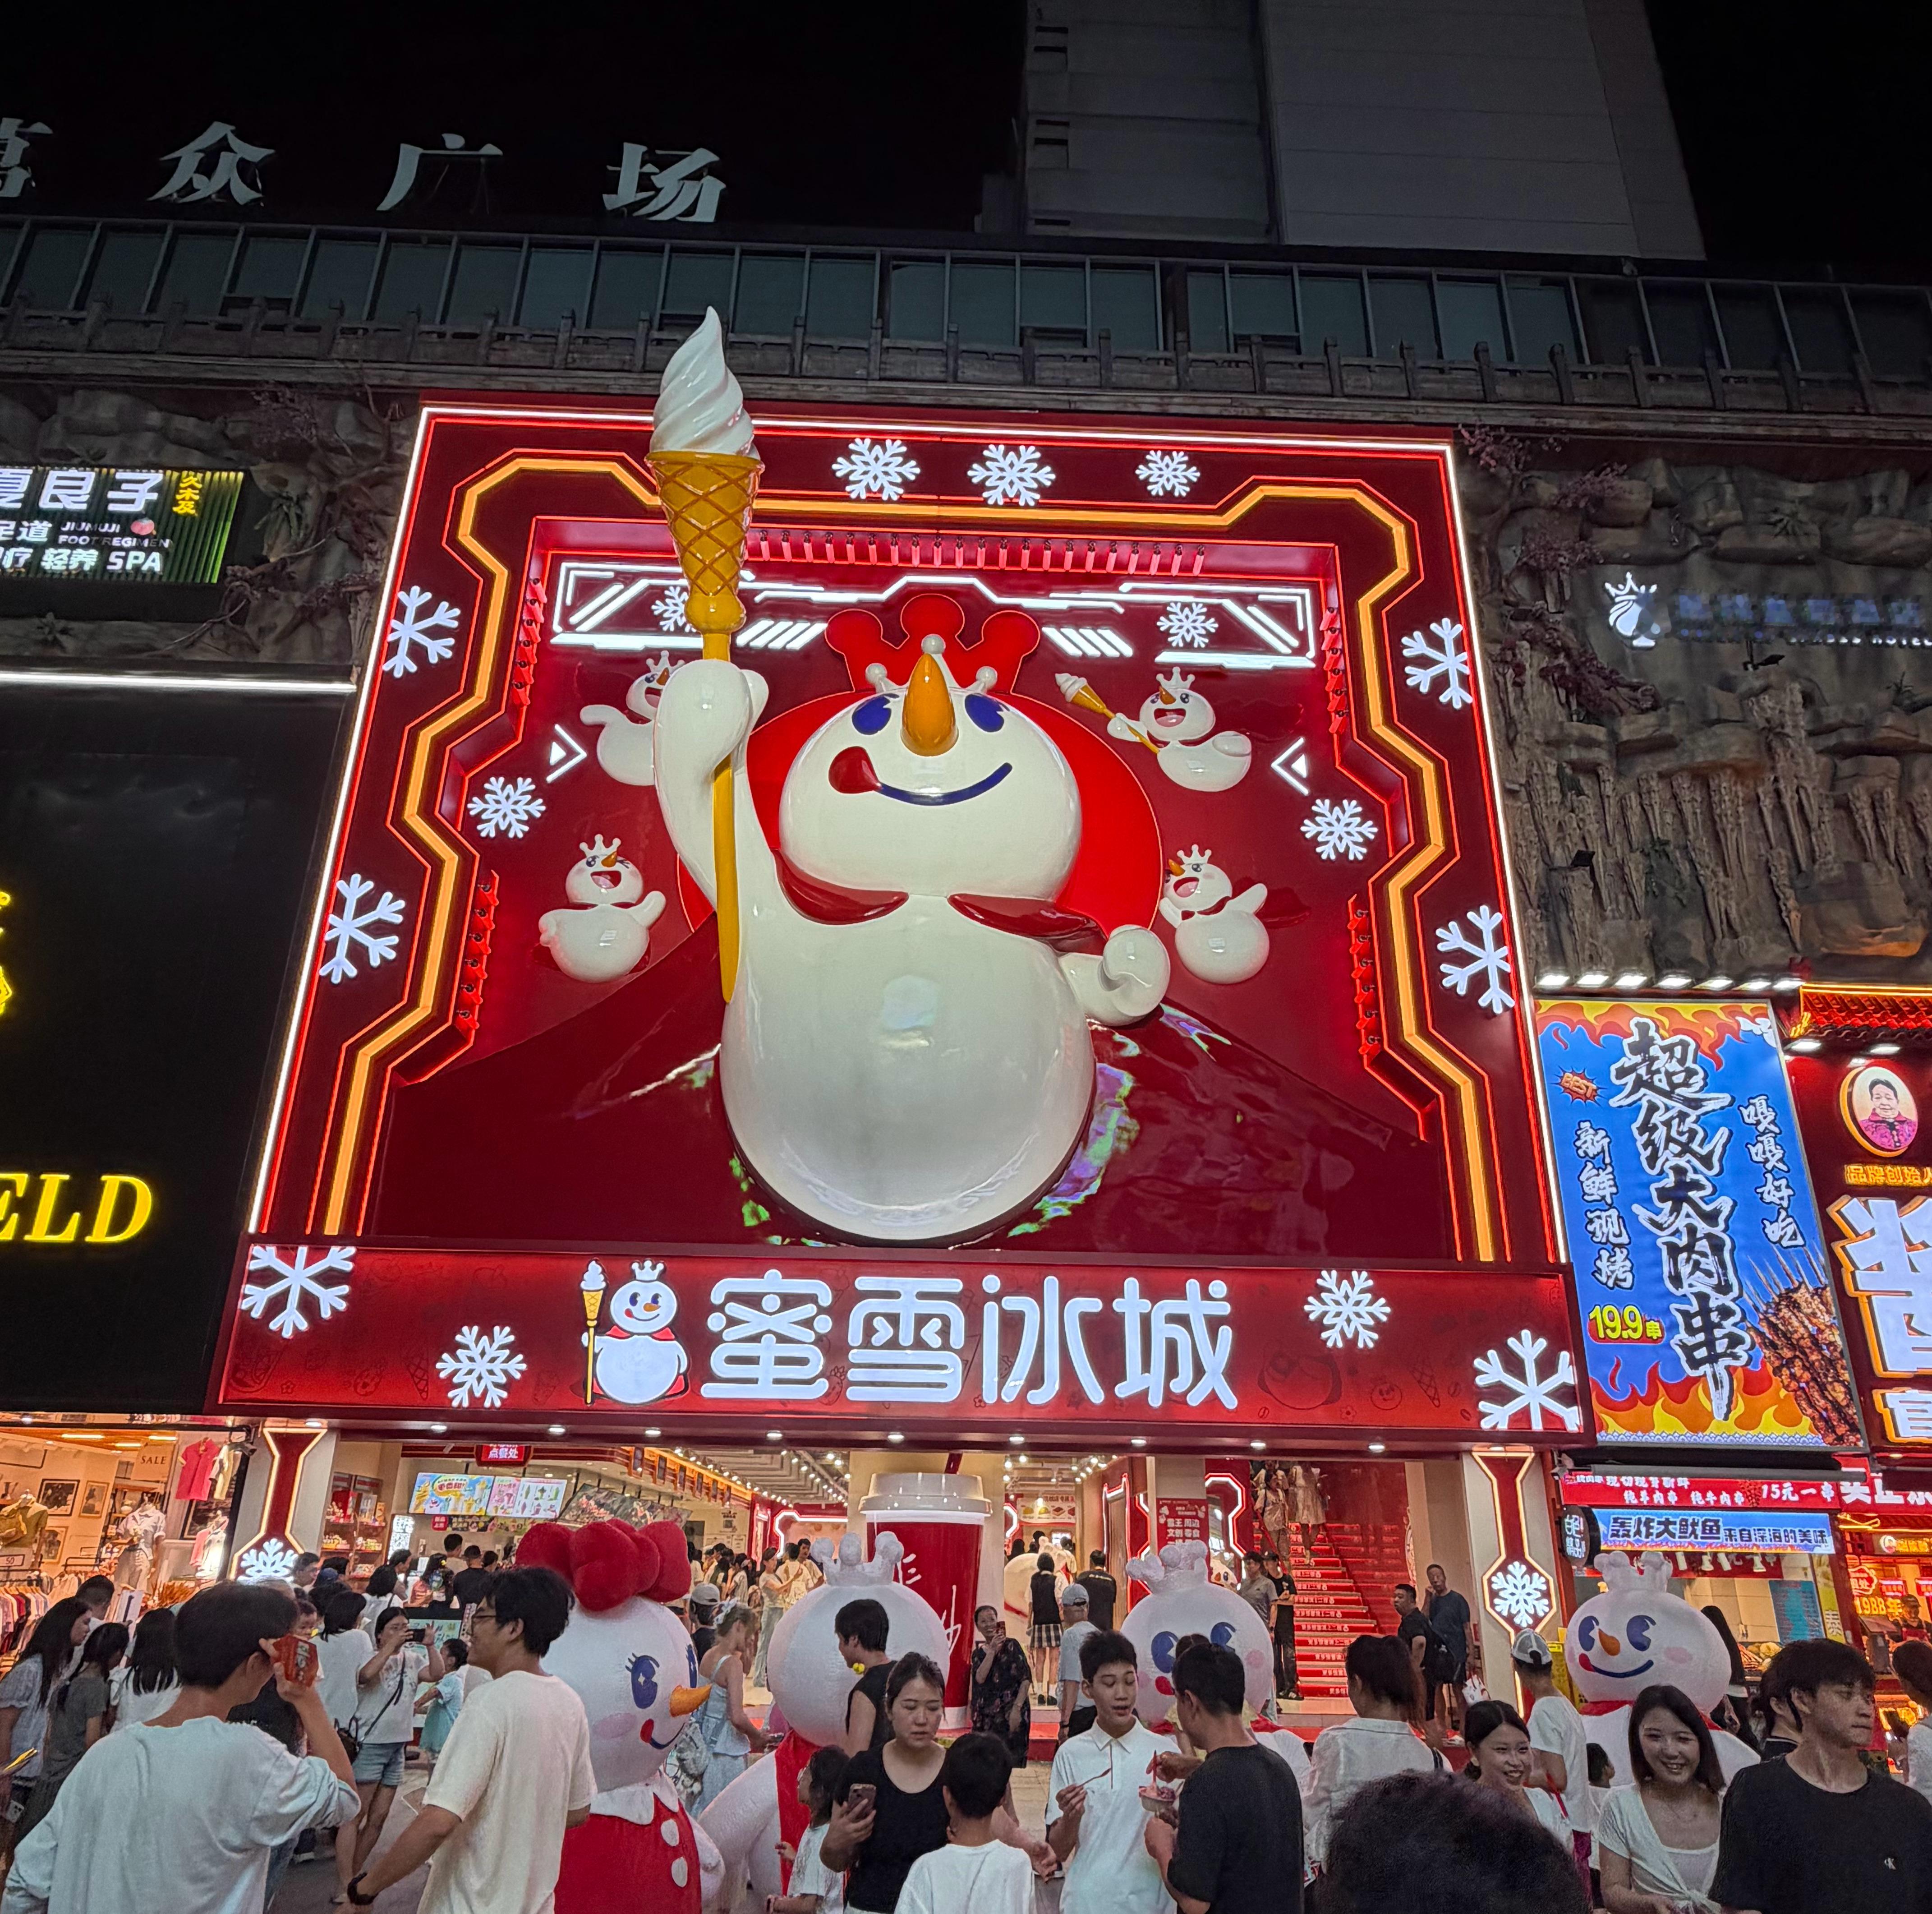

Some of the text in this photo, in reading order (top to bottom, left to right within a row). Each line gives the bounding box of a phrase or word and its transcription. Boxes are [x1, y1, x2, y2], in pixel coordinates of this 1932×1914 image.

[58, 535, 99, 545] FOOT
[107, 551, 163, 572] SPA
[1561, 1072, 1597, 1098] BEST
[1575, 1120, 1634, 1290] 新鲜现烤
[1610, 1017, 1752, 1422] 超级大肉串
[700, 1268, 1239, 1409] 蜜雪冰城
[140, 1454, 167, 1465] SALE
[1762, 1481, 1835, 1502] 15元一串
[1610, 1516, 1722, 1540] 轰炸大鱿鱼
[1723, 1527, 1828, 1545] 来自深海的美味
